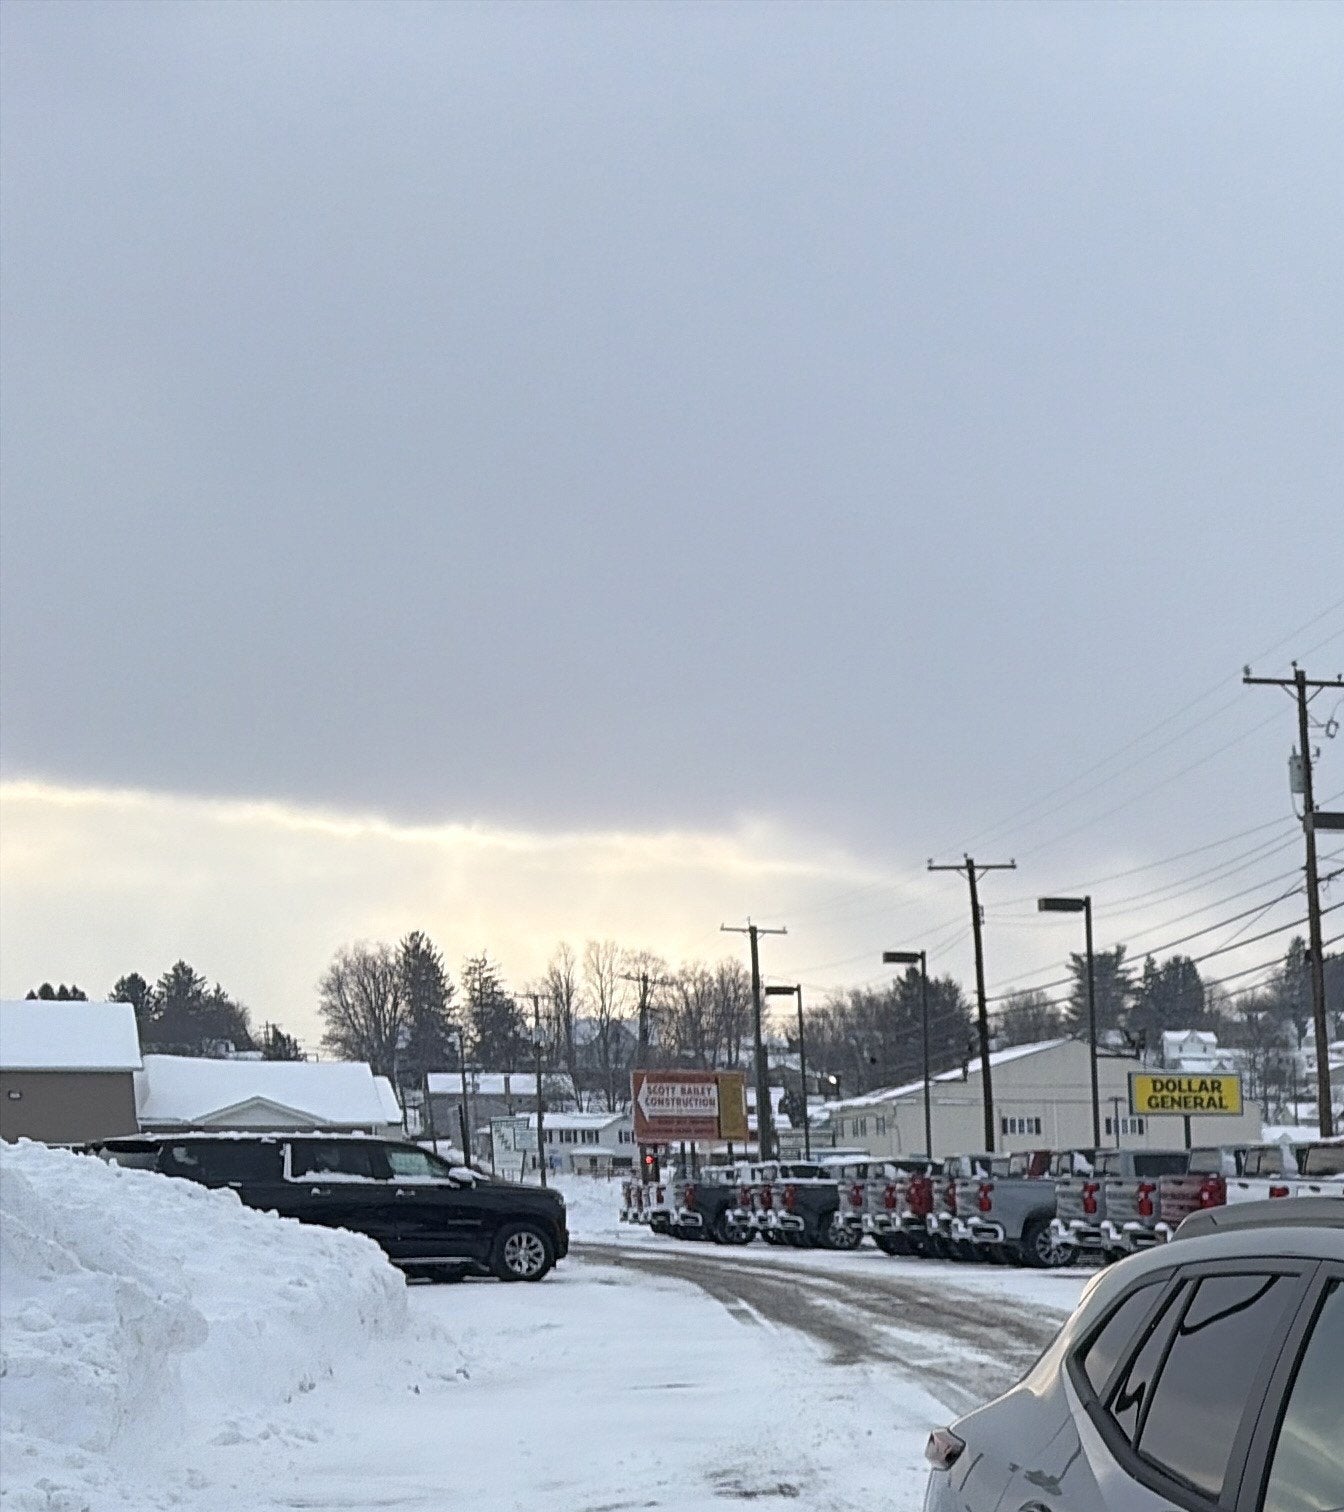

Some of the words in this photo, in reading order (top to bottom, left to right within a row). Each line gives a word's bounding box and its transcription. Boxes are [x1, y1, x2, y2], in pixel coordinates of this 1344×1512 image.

[1151, 1078, 1222, 1094] DOLLAR
[645, 1096, 716, 1107] CONSTRUCTION
[1147, 1095, 1229, 1110] GENERAL
